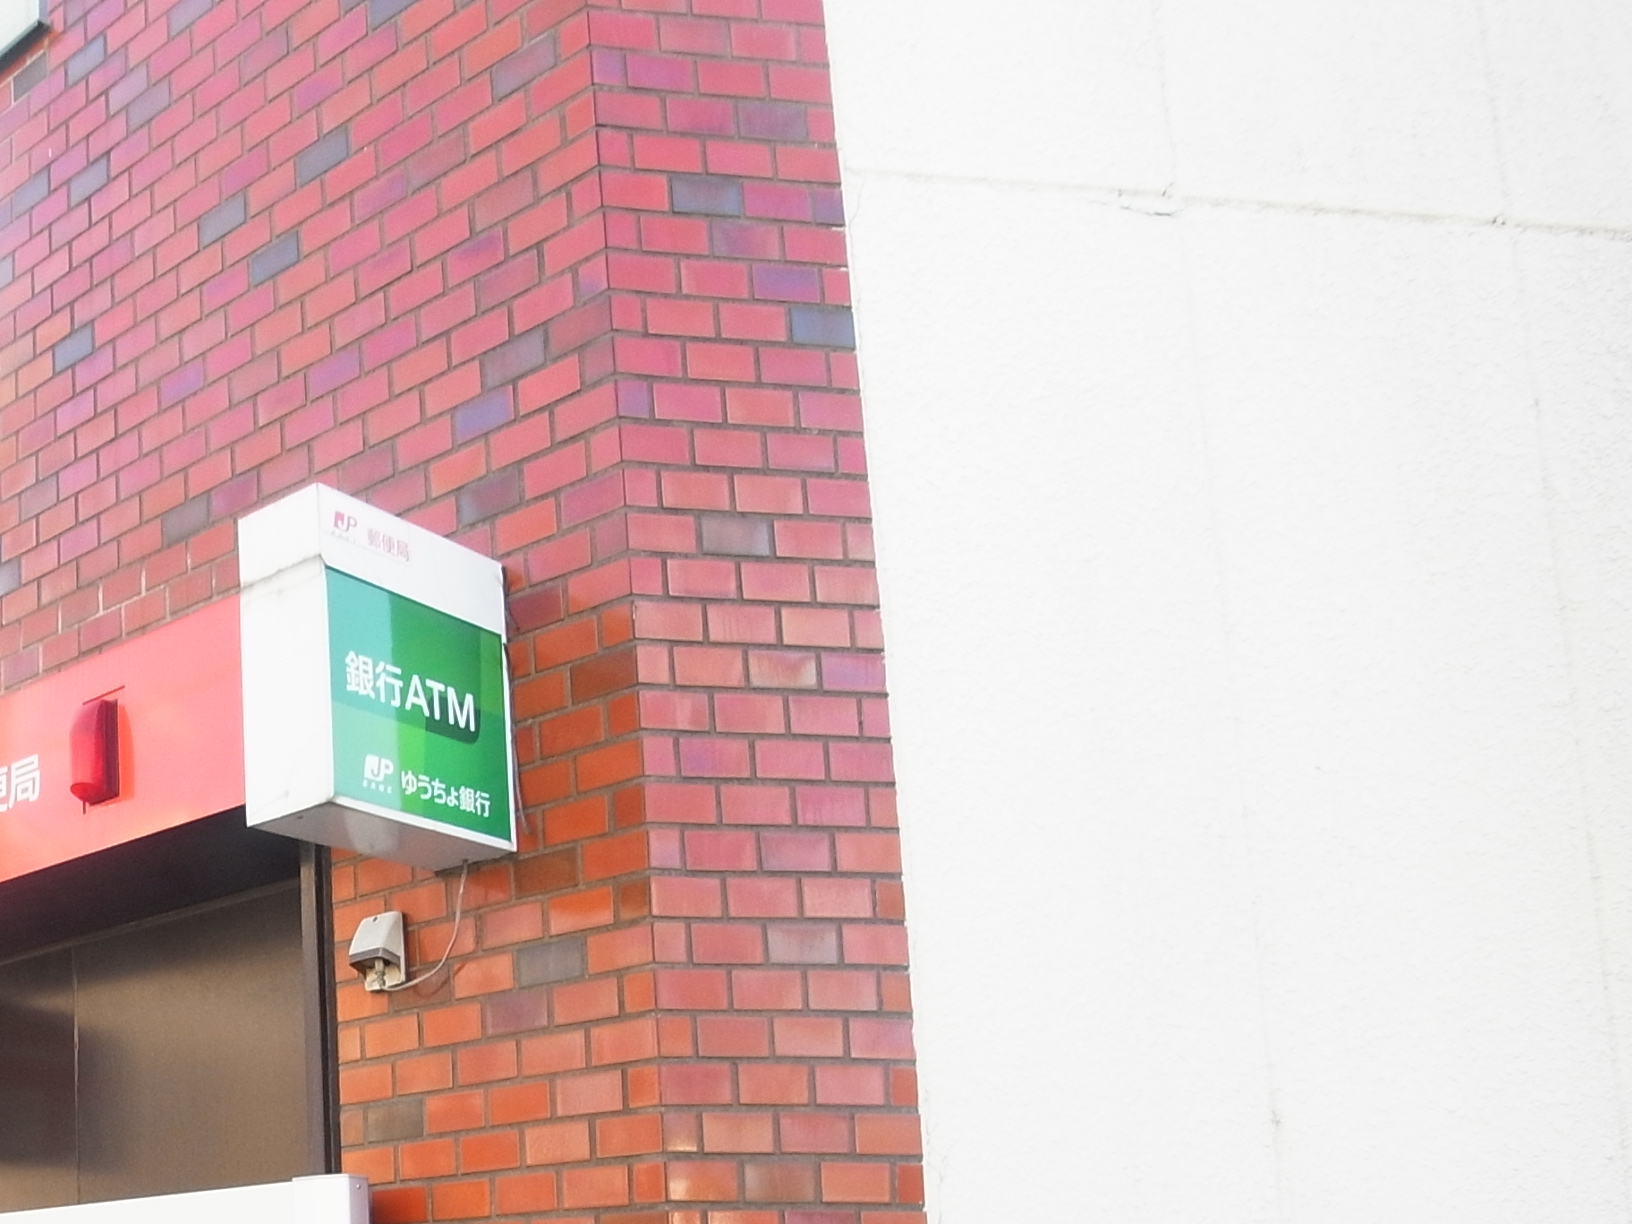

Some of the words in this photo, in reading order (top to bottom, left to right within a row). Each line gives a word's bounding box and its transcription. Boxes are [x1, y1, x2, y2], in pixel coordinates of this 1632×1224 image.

[345, 651, 476, 732] 銀行ATM
[401, 770, 491, 818] ゆうちょ銀行
